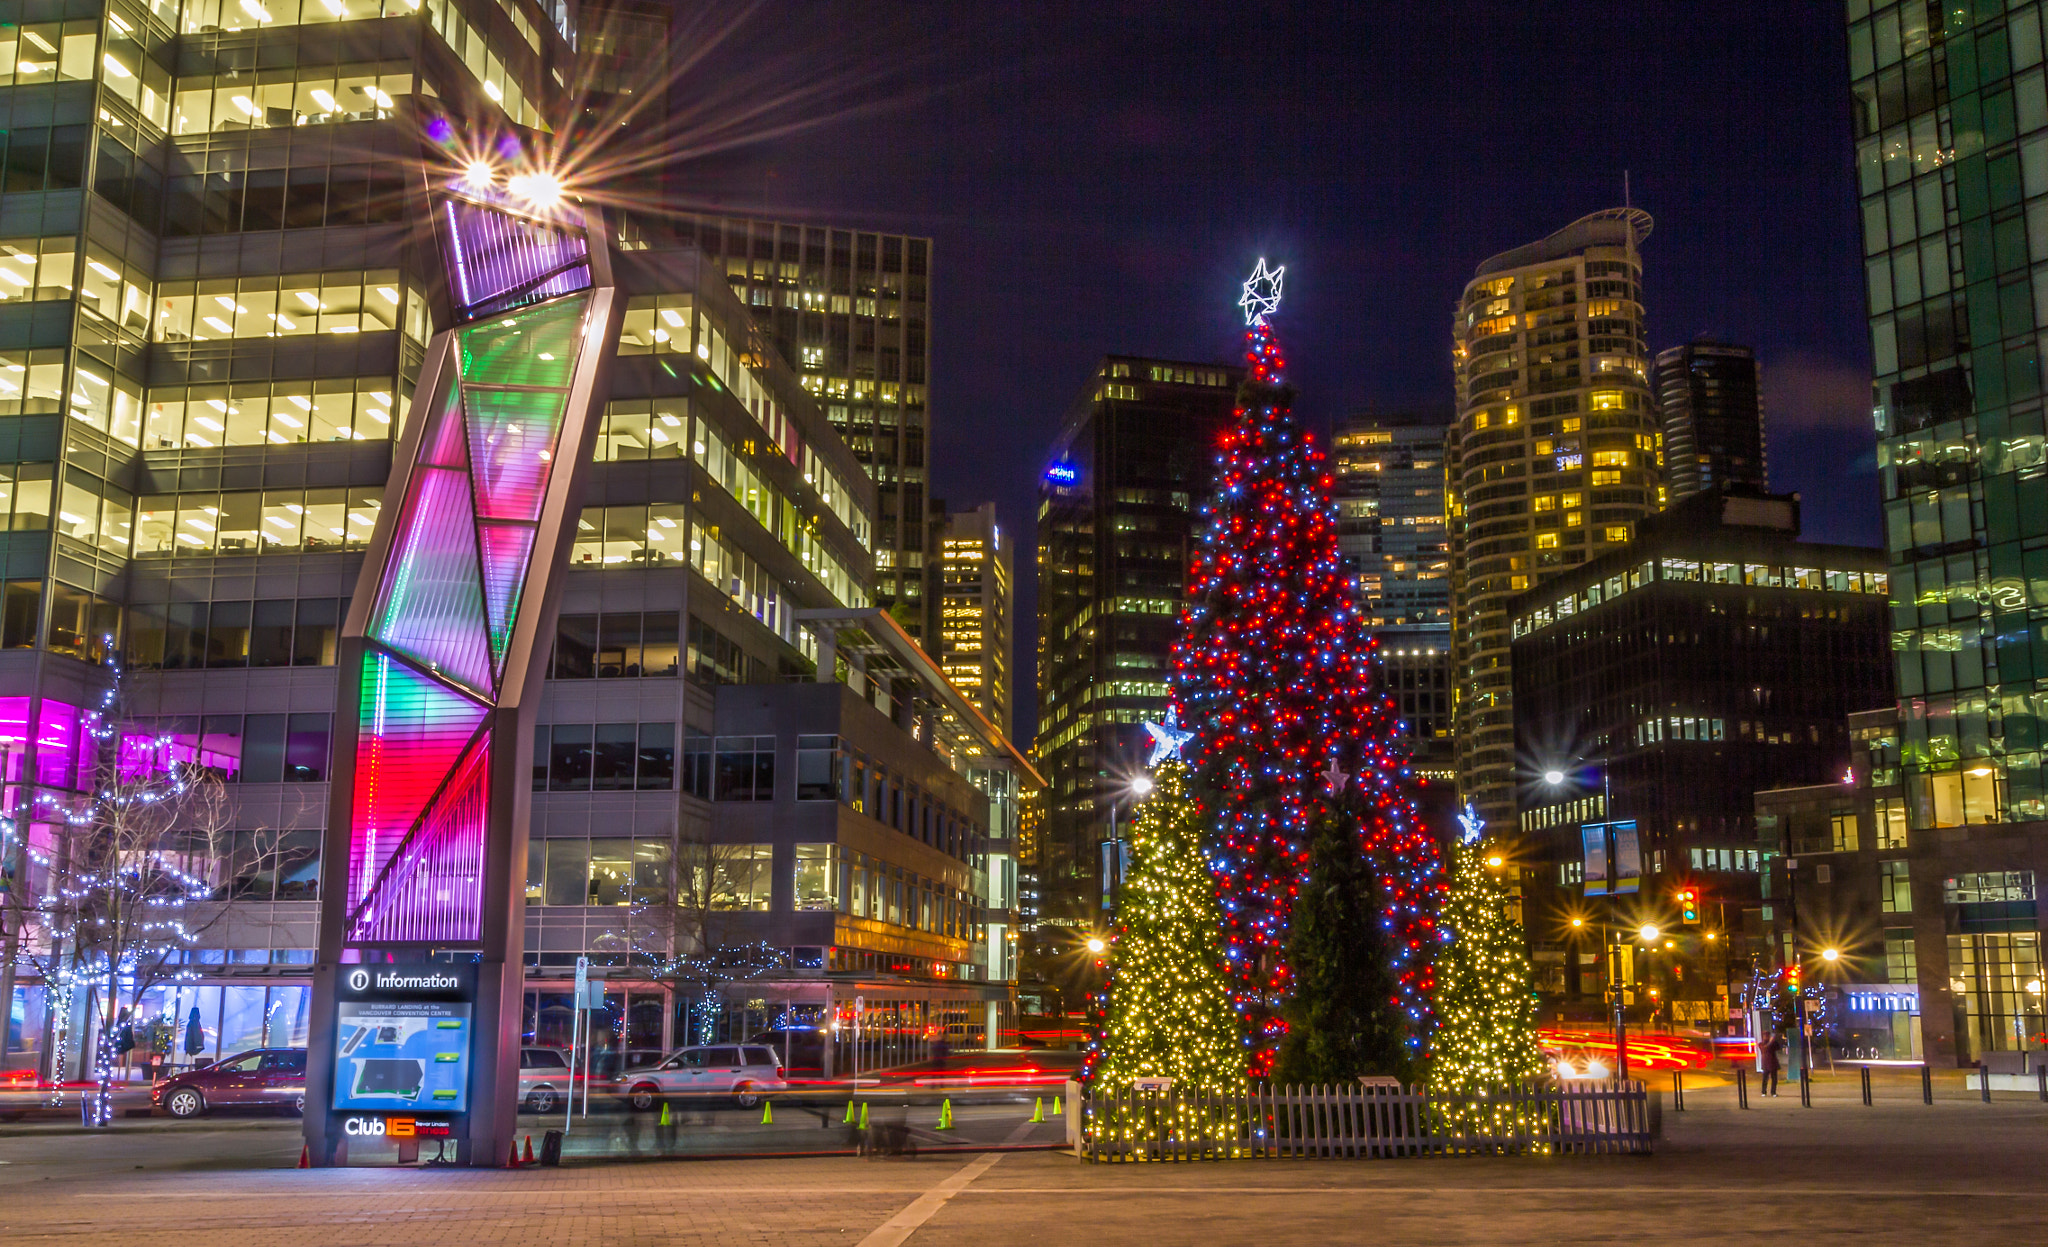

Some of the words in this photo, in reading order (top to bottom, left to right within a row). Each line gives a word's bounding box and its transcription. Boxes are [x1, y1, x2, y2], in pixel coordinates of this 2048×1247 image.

[1618, 832, 1636, 841] VAN
[376, 972, 458, 988] Information
[344, 1117, 386, 1136] Club
[386, 1118, 416, 1136] 16
